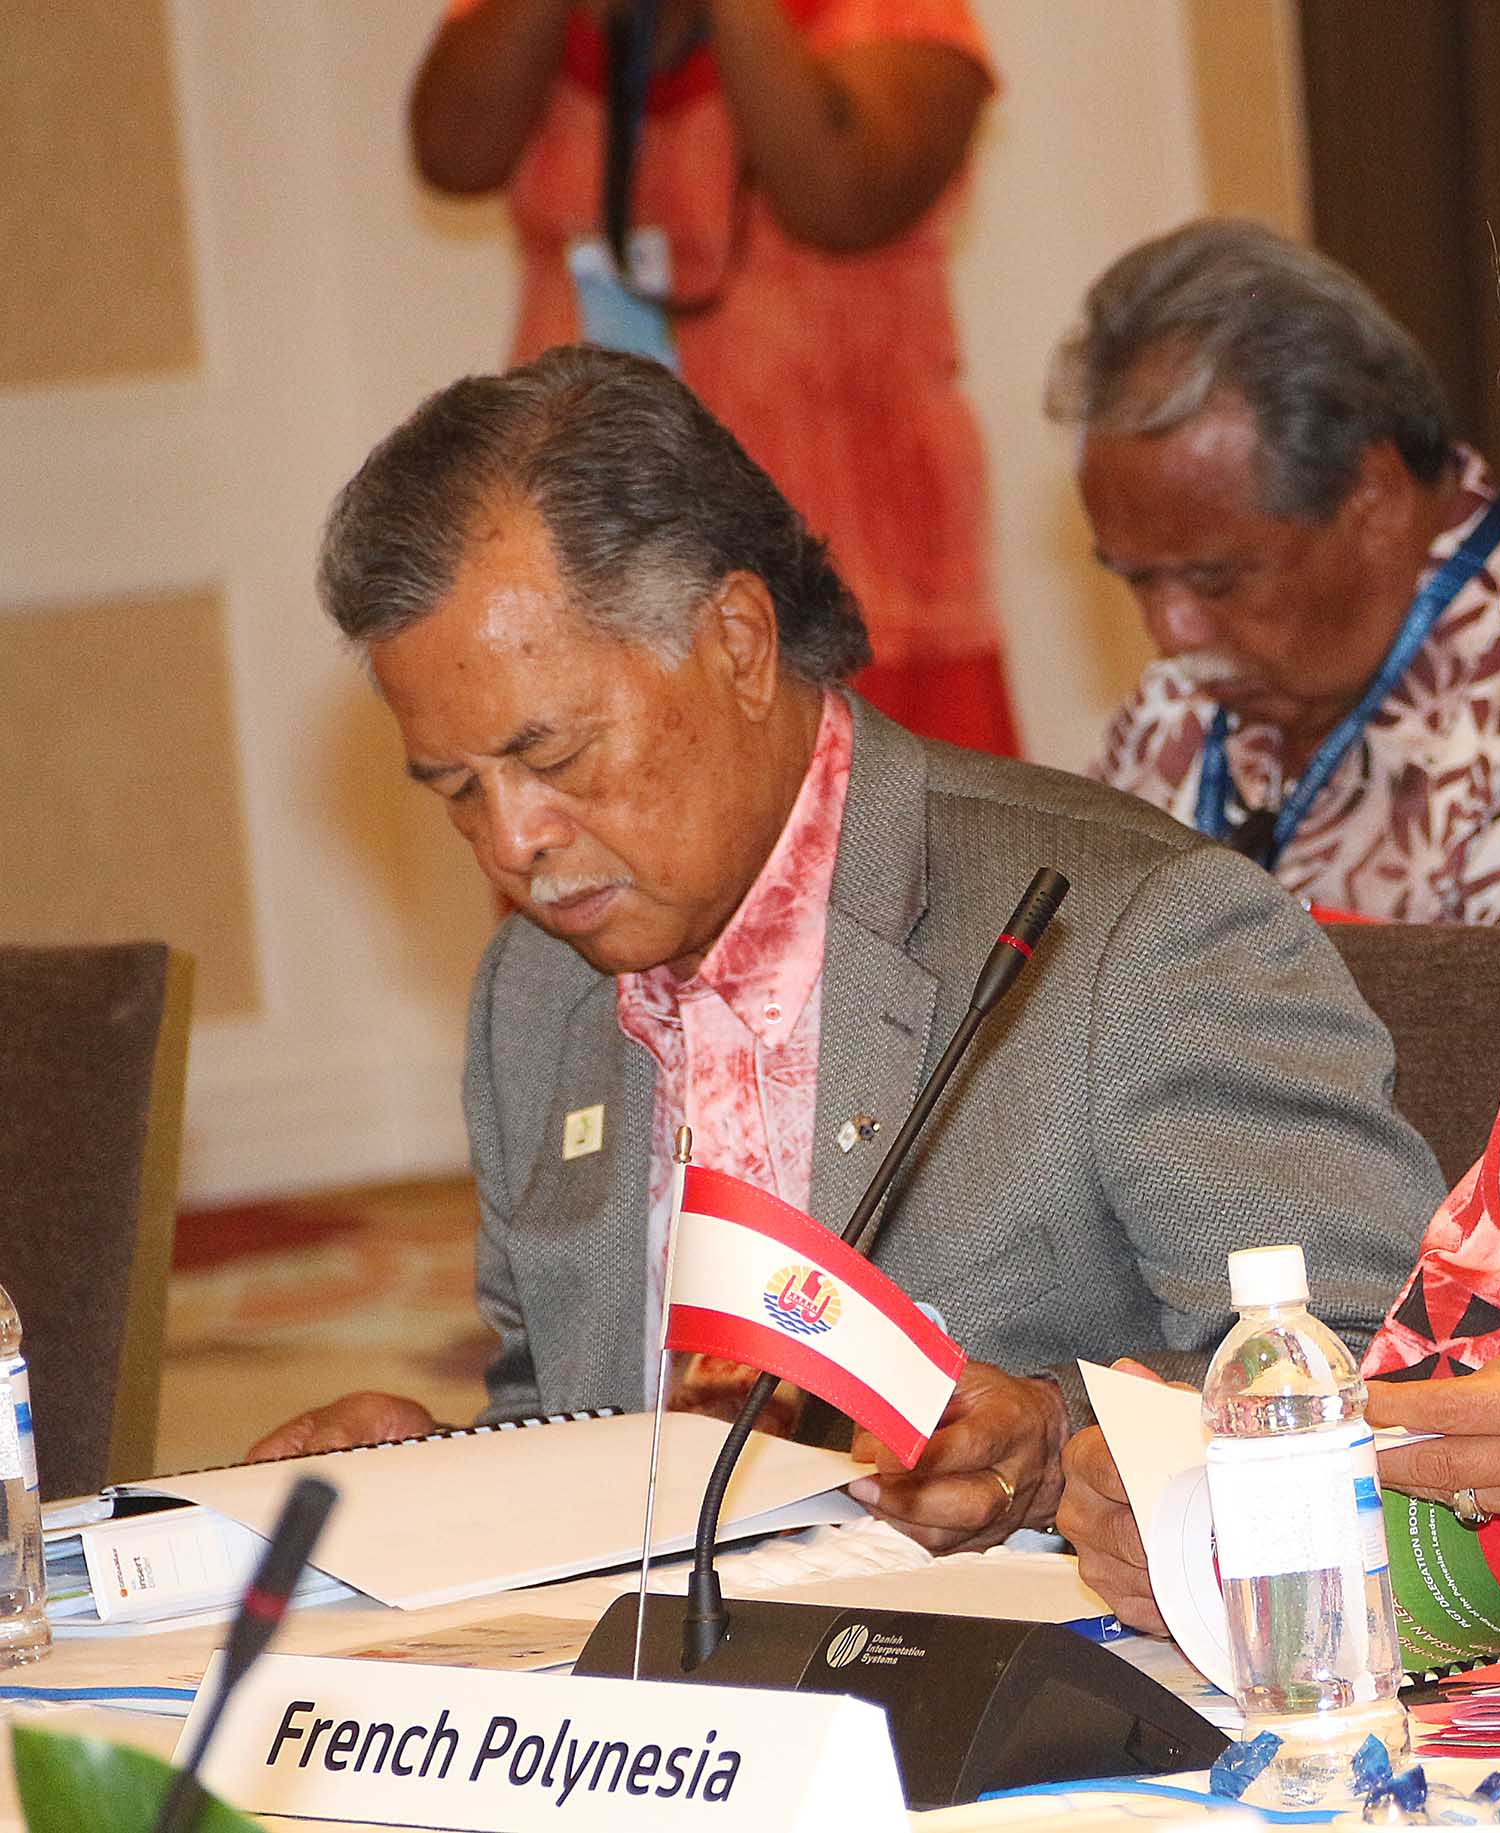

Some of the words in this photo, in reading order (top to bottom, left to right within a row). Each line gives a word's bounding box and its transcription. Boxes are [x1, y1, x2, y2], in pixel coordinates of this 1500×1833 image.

[1428, 1508, 1439, 1547] Leaders
[1411, 1538, 1450, 1607] DELEGATION
[1435, 1549, 1462, 1597] Polynesian
[1459, 1597, 1472, 1610] the
[1445, 1608, 1472, 1628] PLG7
[872, 1633, 903, 1645] Danish
[860, 1653, 898, 1665] Systems
[865, 1643, 926, 1657] Interpretation
[265, 1700, 460, 1779] French
[468, 1715, 742, 1807] Polynesia
